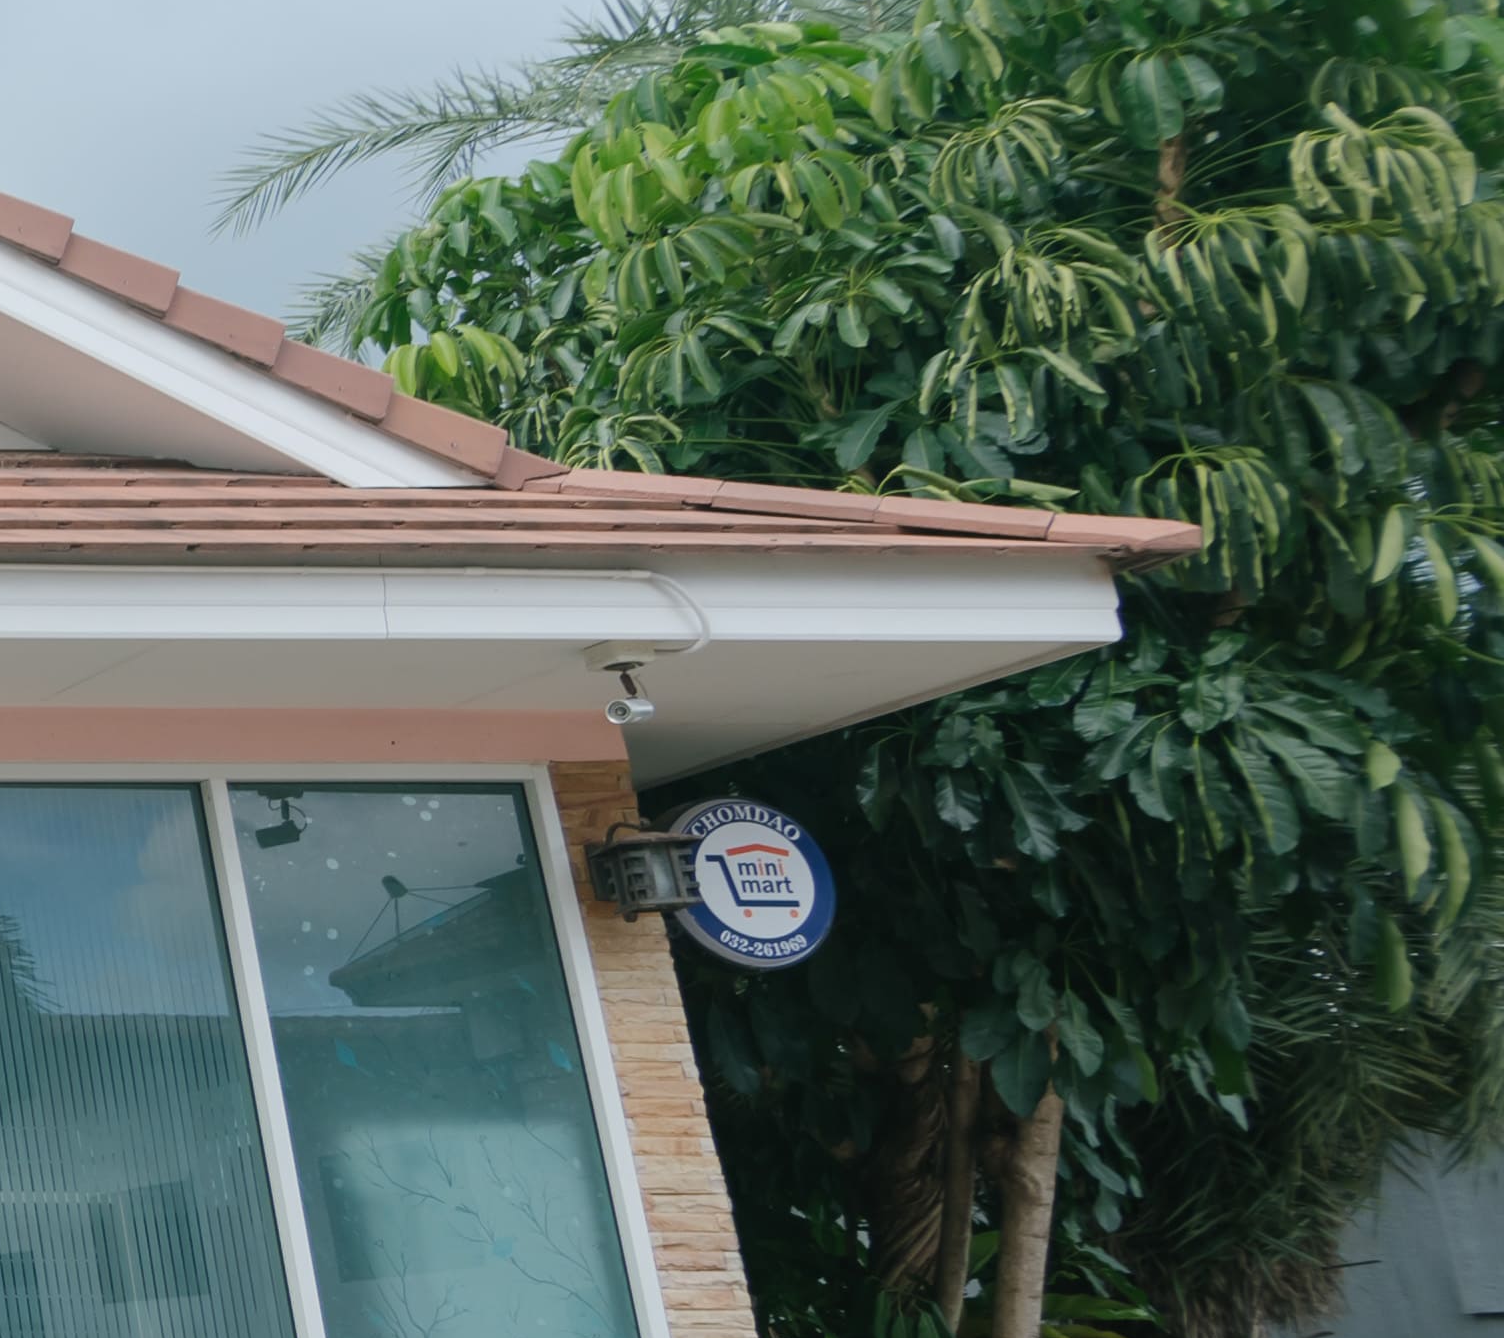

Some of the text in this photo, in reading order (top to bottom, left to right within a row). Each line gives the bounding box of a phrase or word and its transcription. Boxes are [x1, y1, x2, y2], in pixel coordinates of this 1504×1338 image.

[691, 804, 801, 841] CHOMDAO
[738, 858, 785, 876] mini
[741, 876, 794, 894] mart
[720, 929, 807, 957] 032-261969
